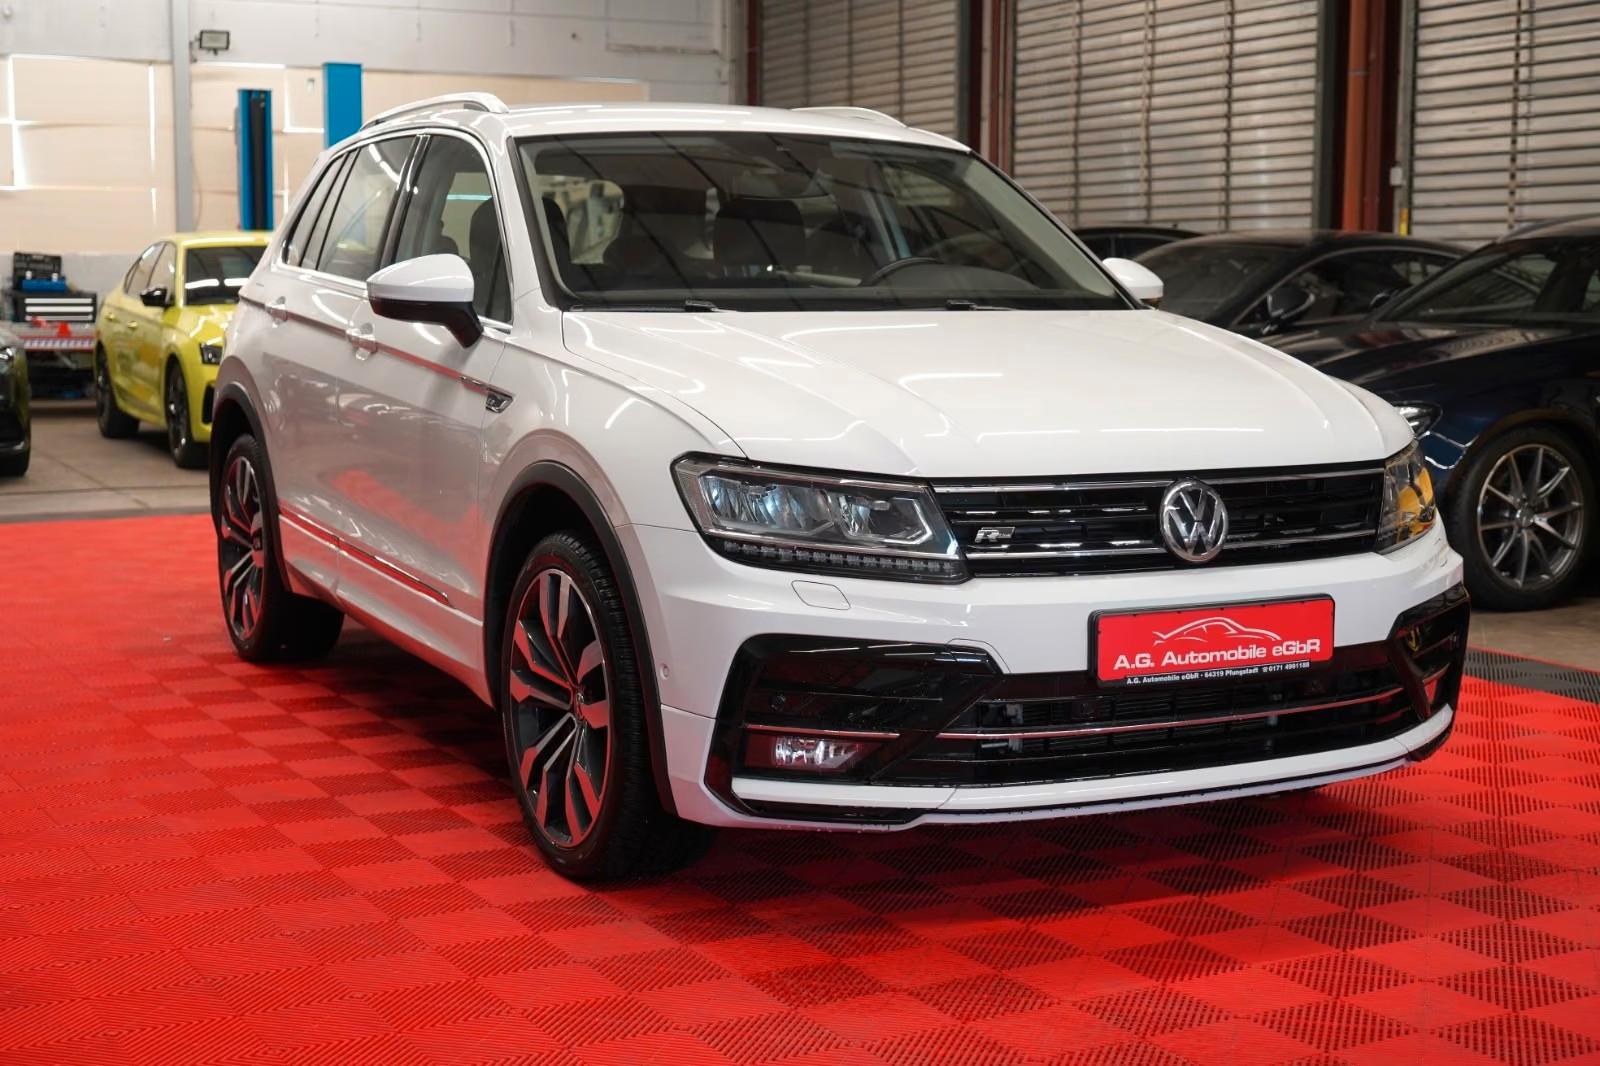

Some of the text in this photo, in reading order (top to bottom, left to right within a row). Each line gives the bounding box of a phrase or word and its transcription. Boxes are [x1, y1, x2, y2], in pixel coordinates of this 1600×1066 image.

[1113, 639, 1320, 670] A.G. Automobile eGbR
[1126, 677, 1141, 685] A.G.
[1142, 675, 1180, 683] Automobile
